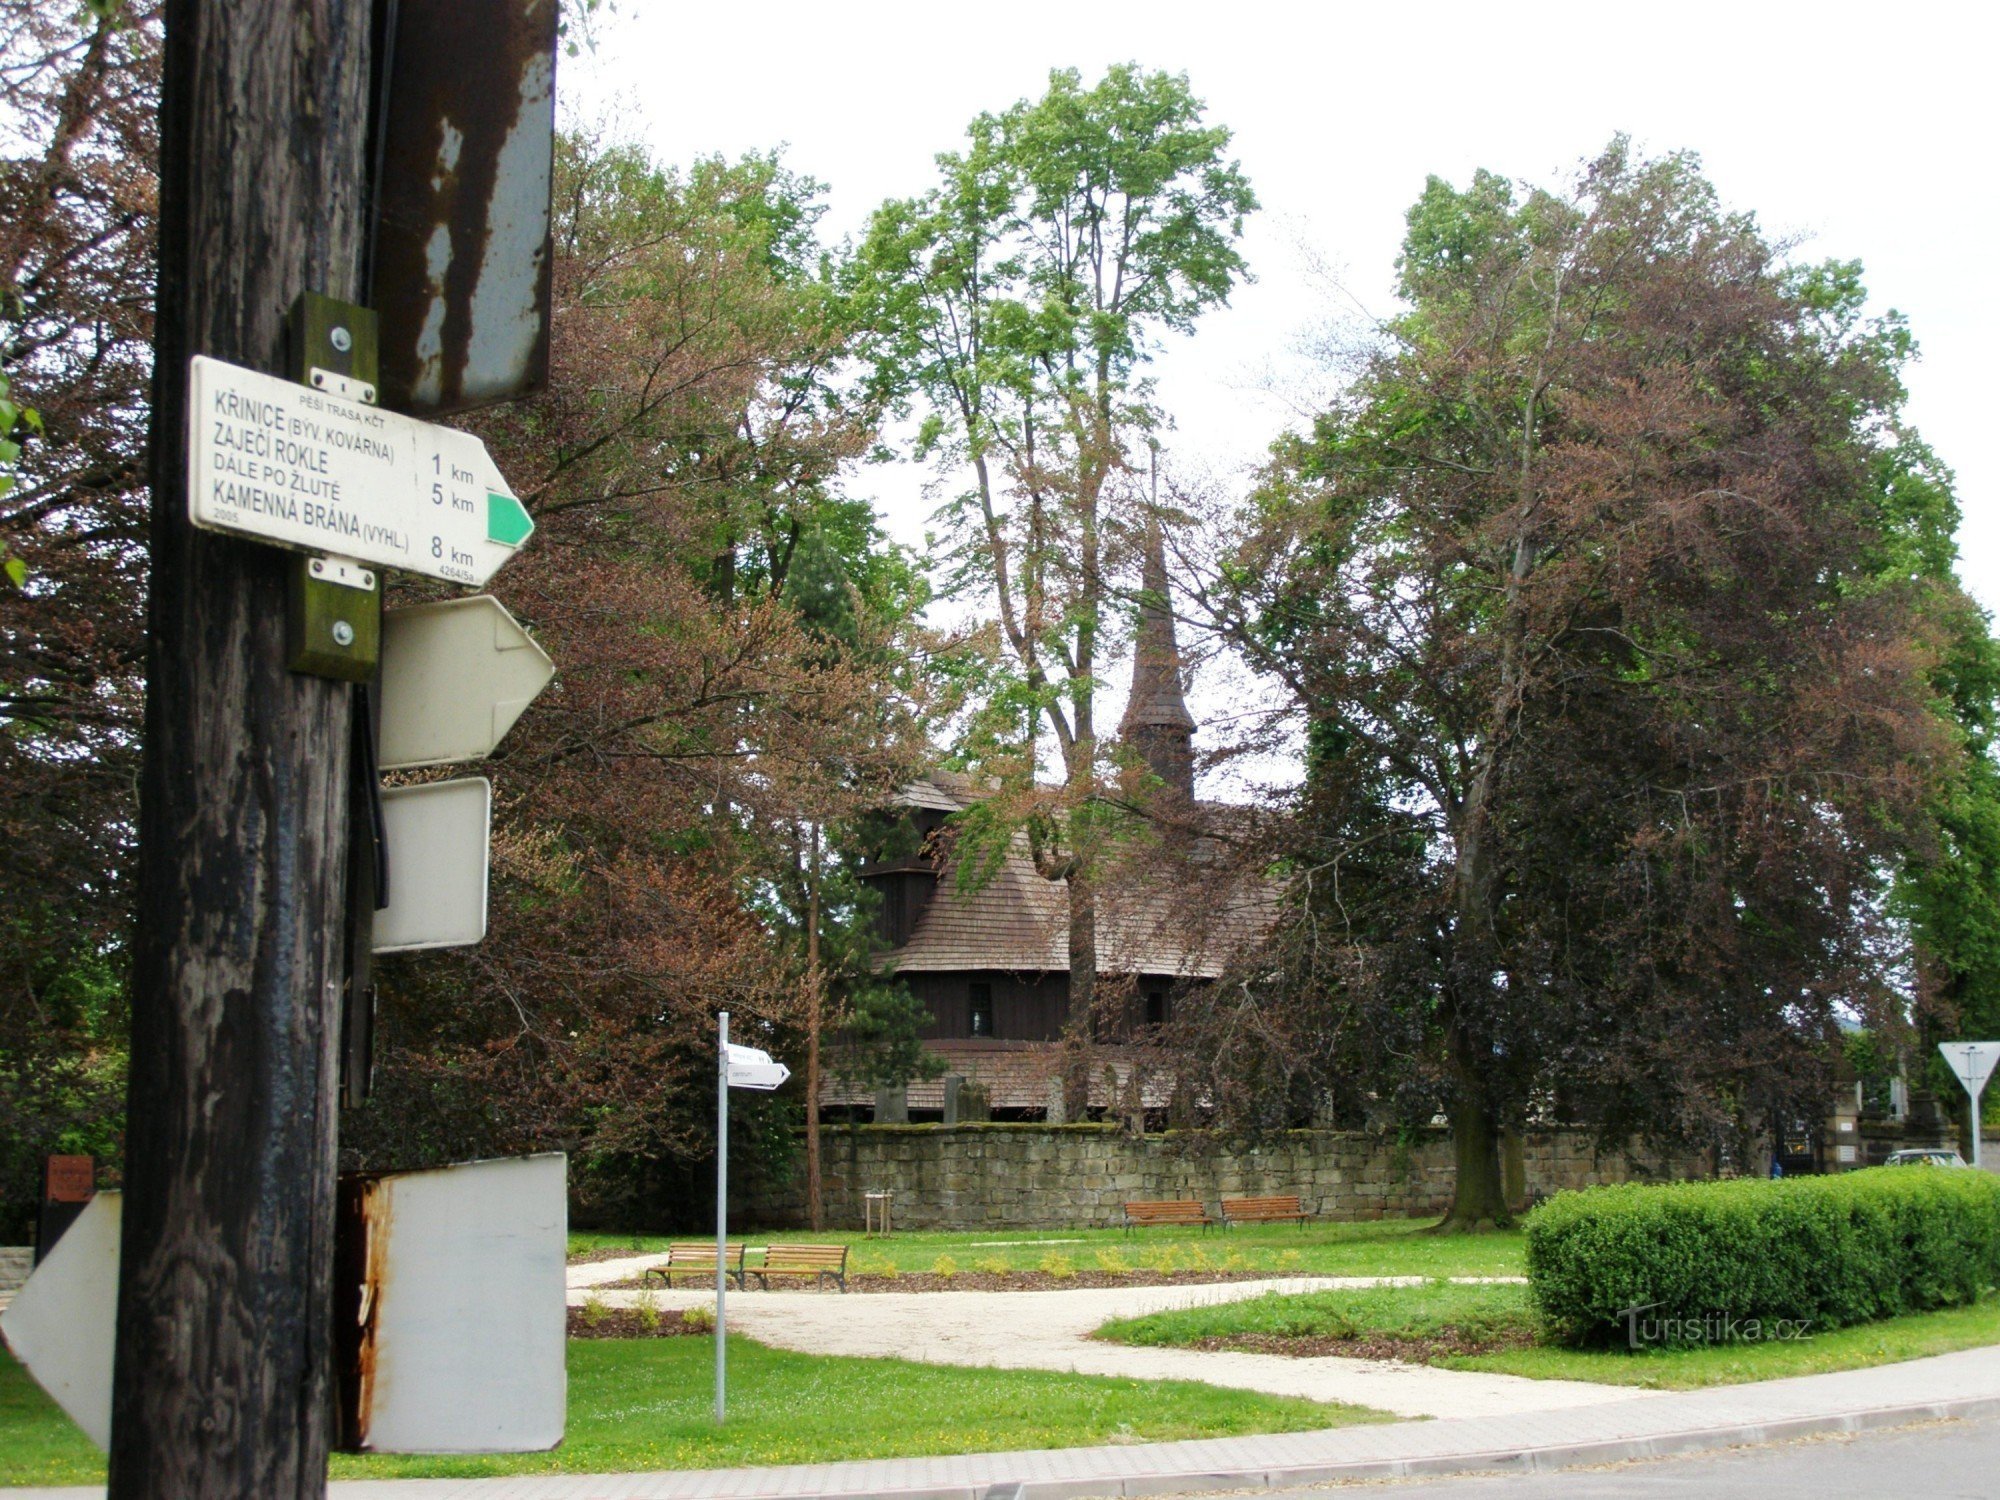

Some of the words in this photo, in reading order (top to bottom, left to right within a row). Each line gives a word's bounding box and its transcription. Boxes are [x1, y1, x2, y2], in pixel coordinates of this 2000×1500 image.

[215, 388, 285, 431] KŘINICE
[288, 417, 322, 442] (BÝV.
[325, 428, 394, 467] KOVÁRNA)
[432, 453, 440, 475] 1
[452, 464, 474, 485] km
[300, 395, 324, 412] PĚŠÍ
[327, 403, 362, 424] TRASA
[364, 415, 386, 430] KČT
[214, 421, 271, 459] ZAJEČÍ
[275, 438, 328, 474] ROKLE
[432, 483, 443, 505] 5
[452, 492, 474, 513] km
[214, 452, 259, 480] DÁLE
[263, 465, 286, 487] PO
[290, 469, 341, 501] ŽLUTÉ
[213, 507, 240, 523] 2005
[213, 477, 299, 522] KAMENNÁ
[303, 501, 361, 538] BRÁNA
[363, 523, 409, 554] (VYHL.)
[431, 536, 443, 559] 8
[451, 546, 473, 567] km
